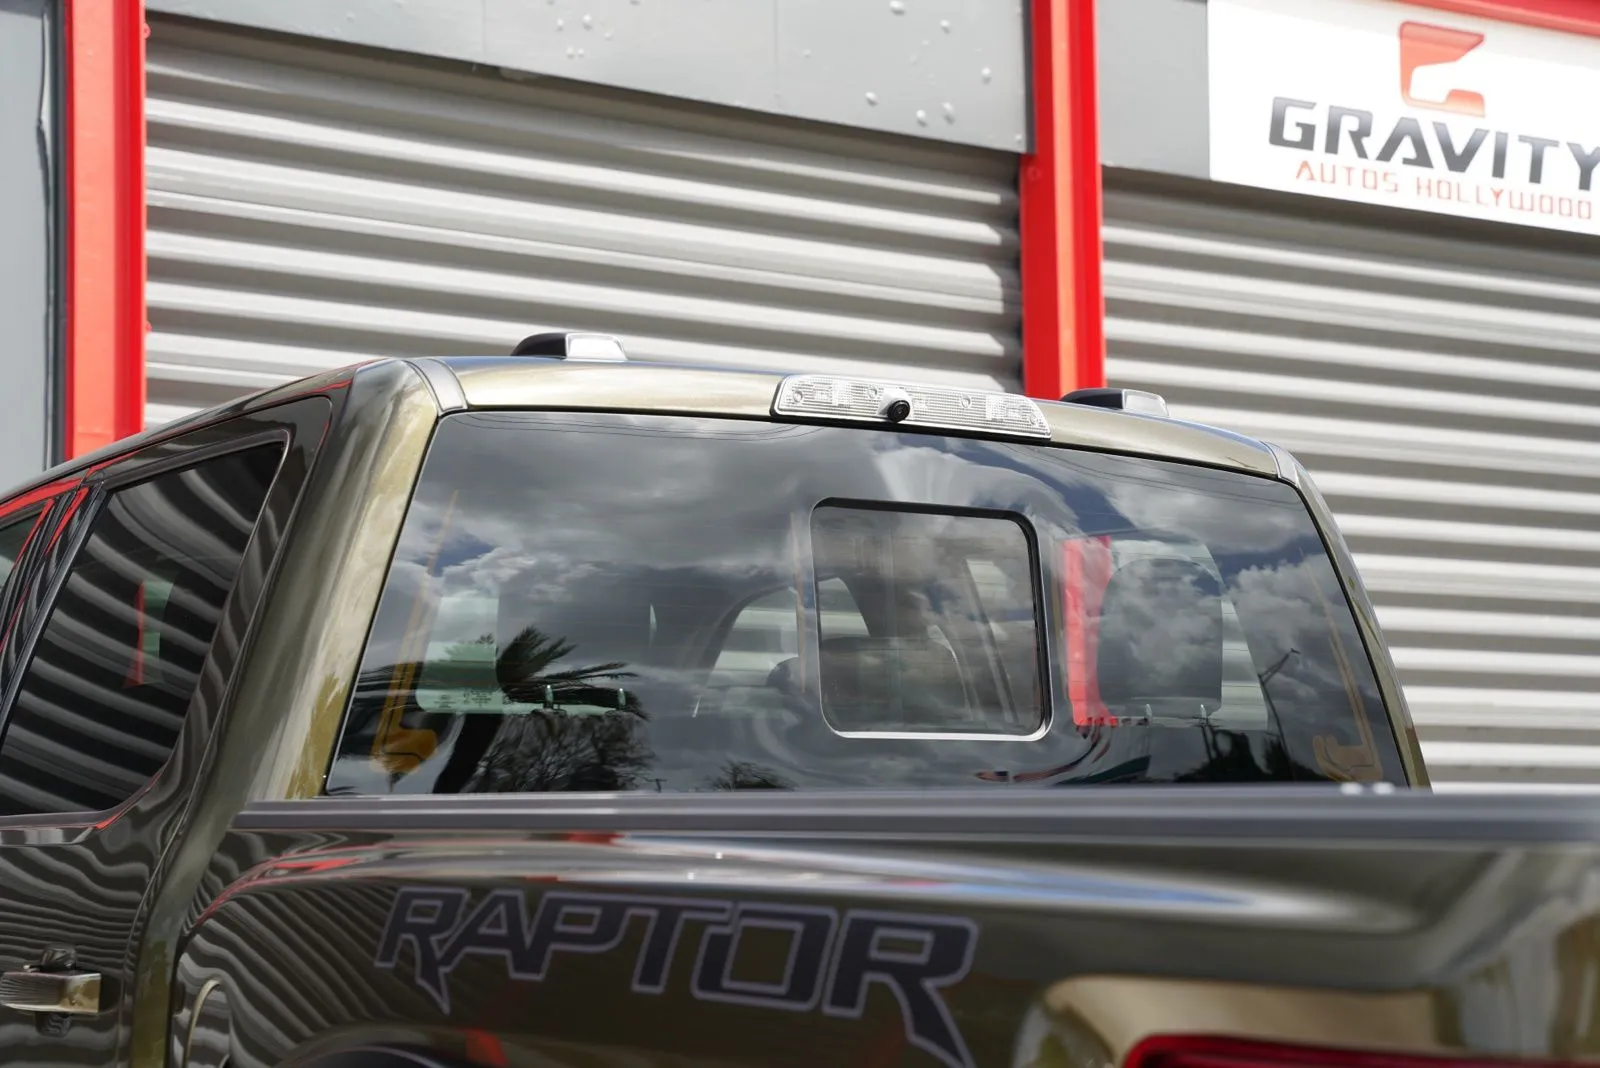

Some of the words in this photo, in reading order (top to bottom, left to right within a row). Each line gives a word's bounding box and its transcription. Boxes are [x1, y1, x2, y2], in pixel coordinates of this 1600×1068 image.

[1268, 96, 1600, 191] GRAVITY
[1296, 160, 1398, 193] AUTOS
[1416, 176, 1592, 219] HOLLYWOOD
[374, 886, 978, 1068] RAPTOR
